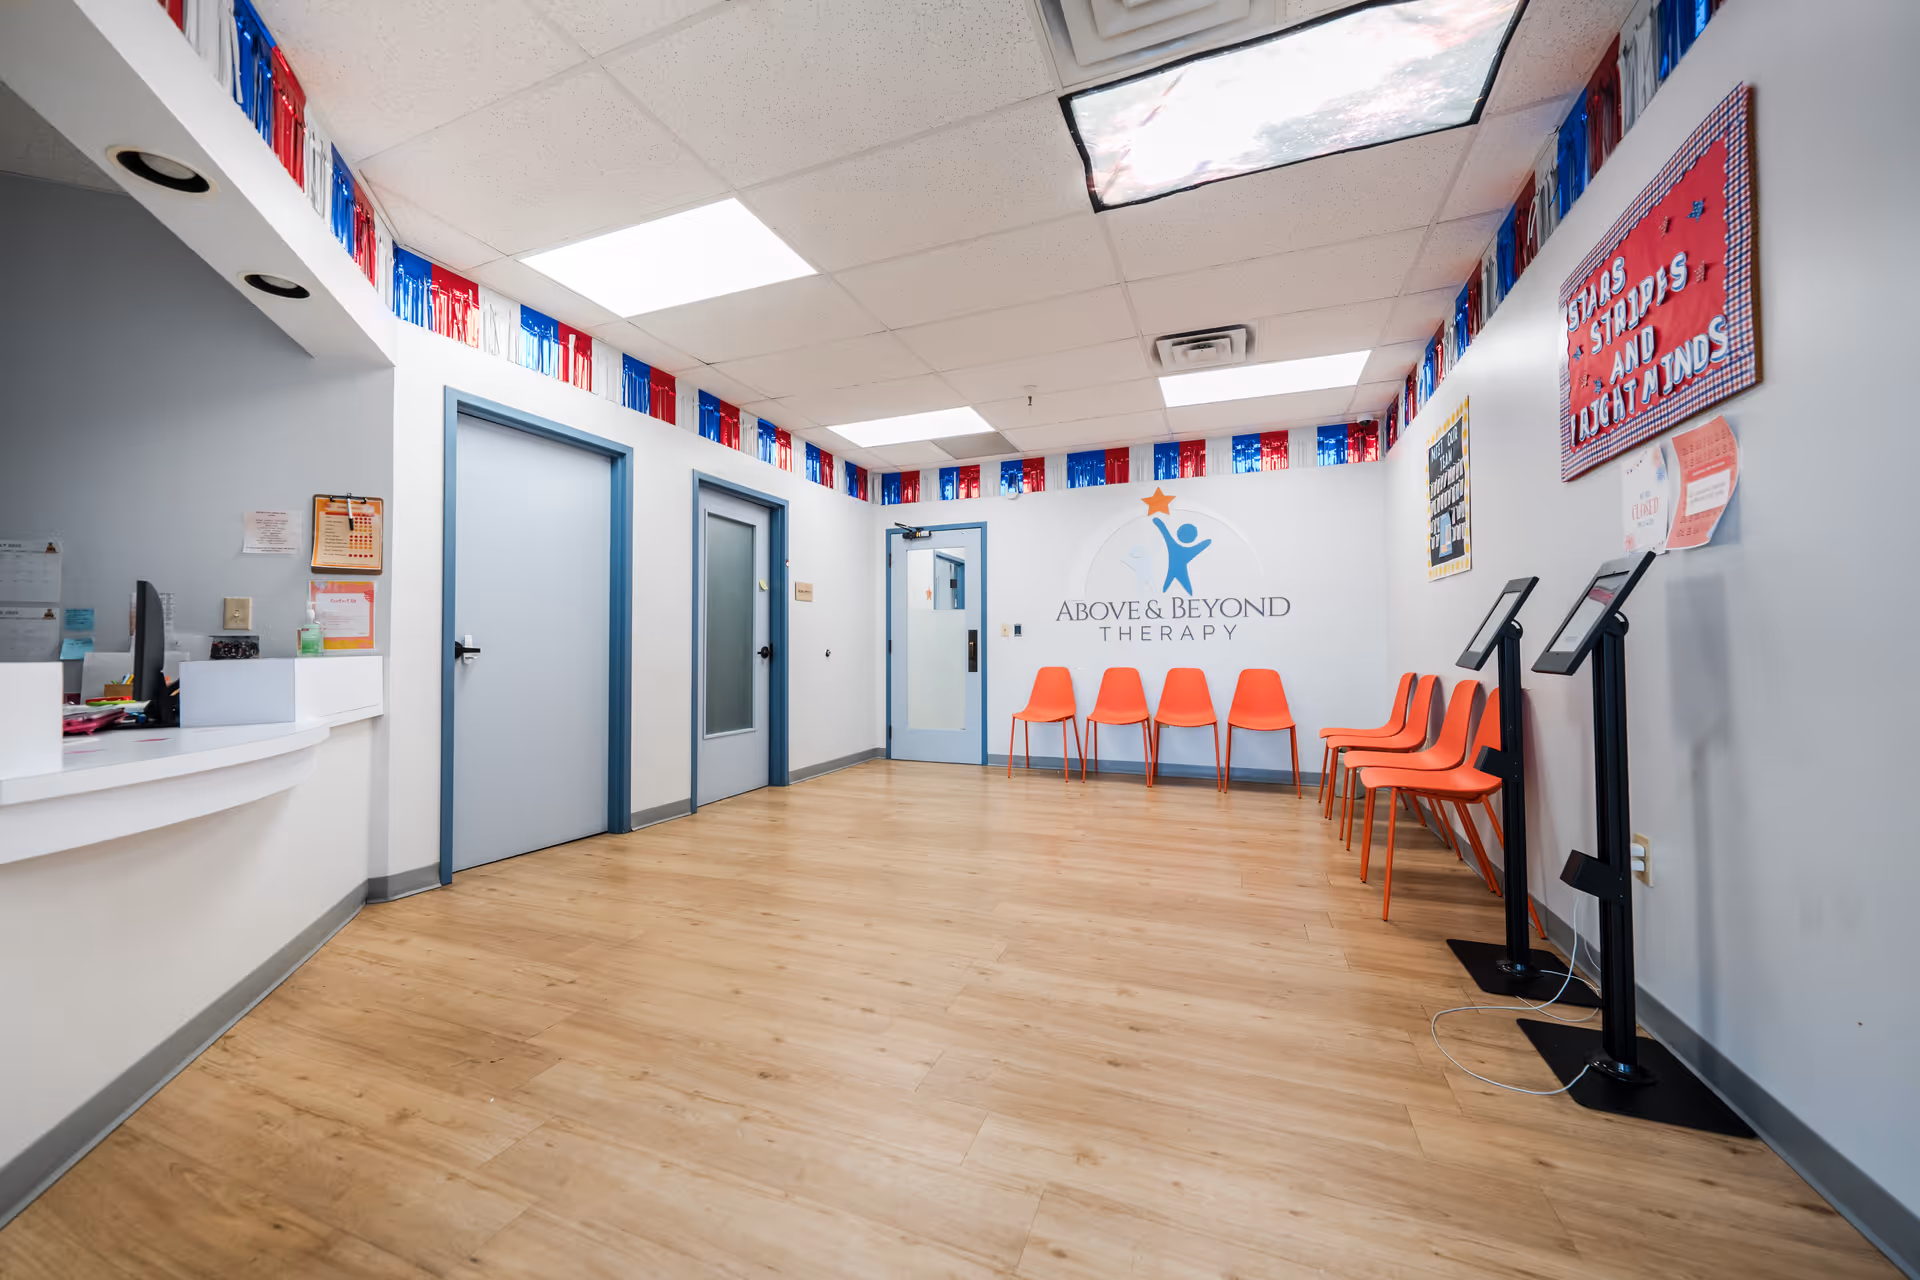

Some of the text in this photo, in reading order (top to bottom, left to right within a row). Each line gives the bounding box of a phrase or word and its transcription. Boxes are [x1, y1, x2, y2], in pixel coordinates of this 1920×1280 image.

[1567, 256, 1626, 332] STARS
[1590, 252, 1688, 355] STRIPES
[1610, 325, 1655, 385] AND
[1641, 315, 1729, 405] MINDS
[1431, 426, 1458, 463] MEET OUR
[1439, 447, 1453, 472] TEAM
[1632, 496, 1659, 521] CLOSED
[1055, 596, 1291, 621] ABOVE & BEYOND
[1099, 624, 1238, 642] THERAPY
